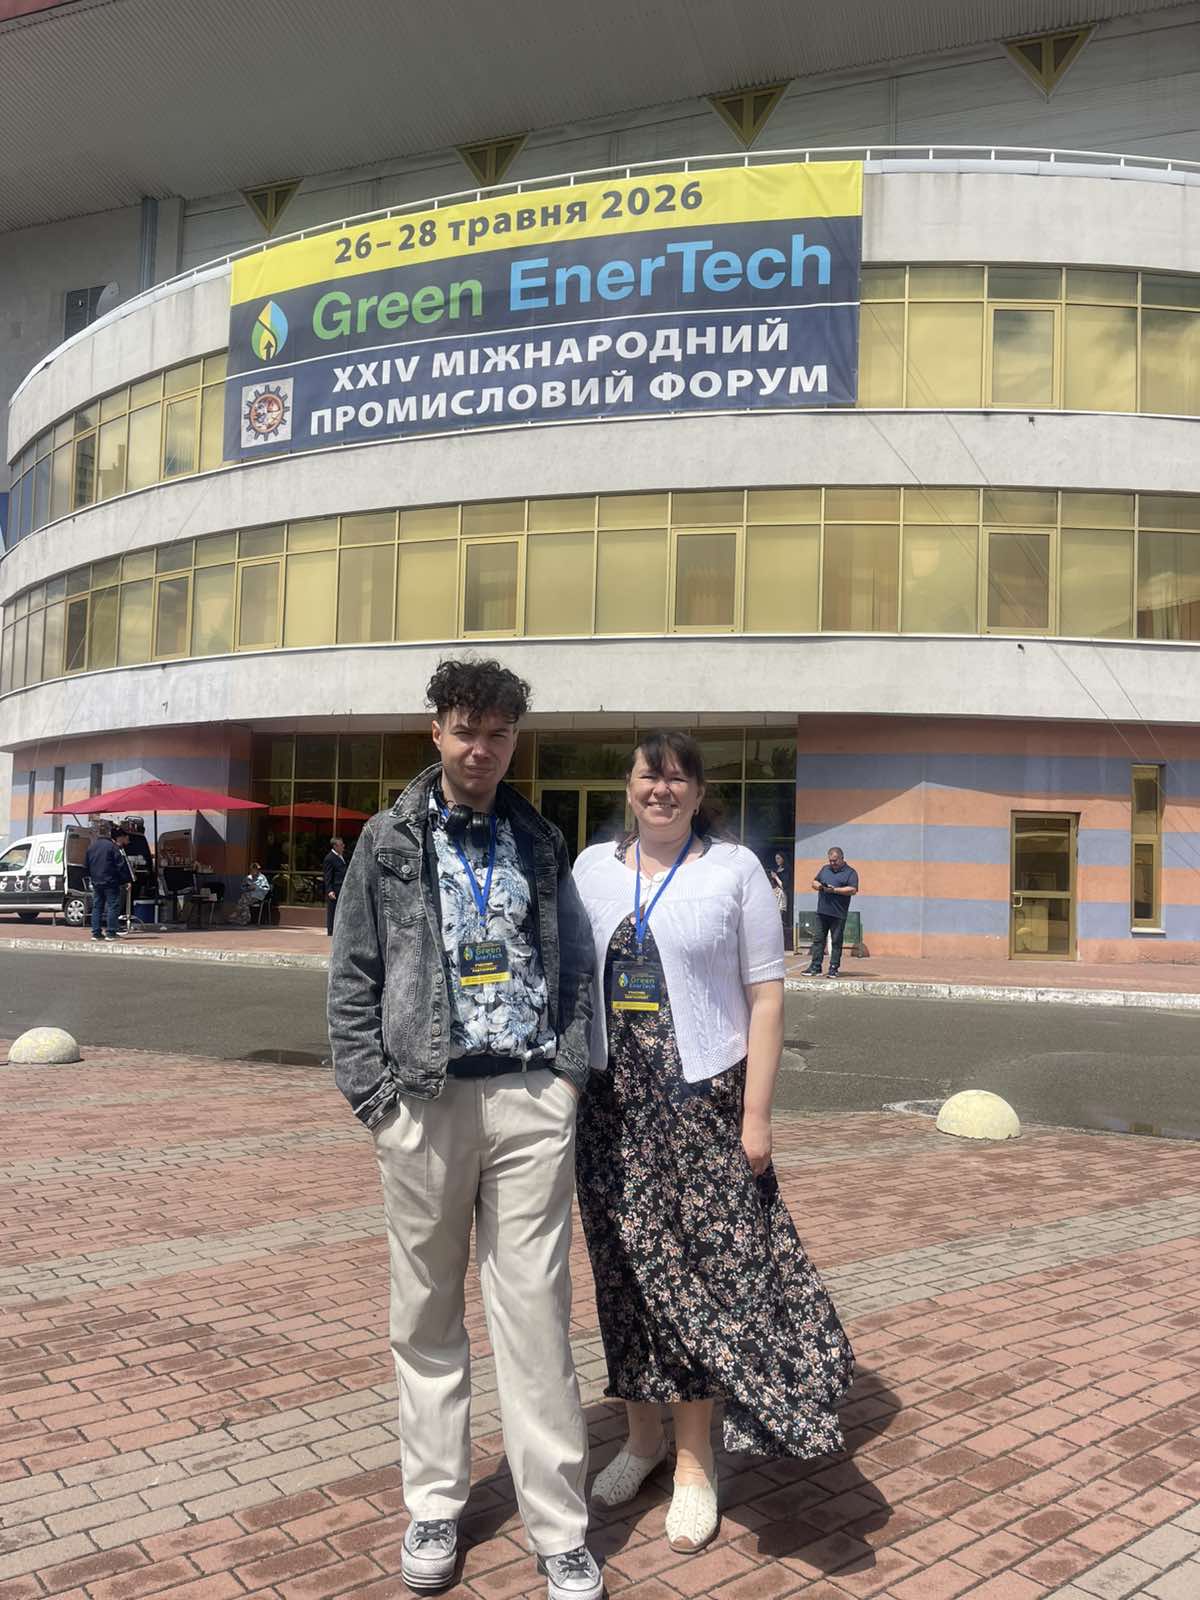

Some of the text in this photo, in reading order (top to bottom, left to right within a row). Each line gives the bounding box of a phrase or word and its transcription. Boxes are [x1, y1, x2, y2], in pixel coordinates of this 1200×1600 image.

[448, 201, 587, 245] травня
[601, 181, 703, 219] 2026
[312, 234, 831, 340] Green EnerTech
[332, 317, 789, 393] XXIV МІЖНАРОДНИЙ
[310, 365, 828, 436] ПРОМИСЛОВИЙ ФОРУМ
